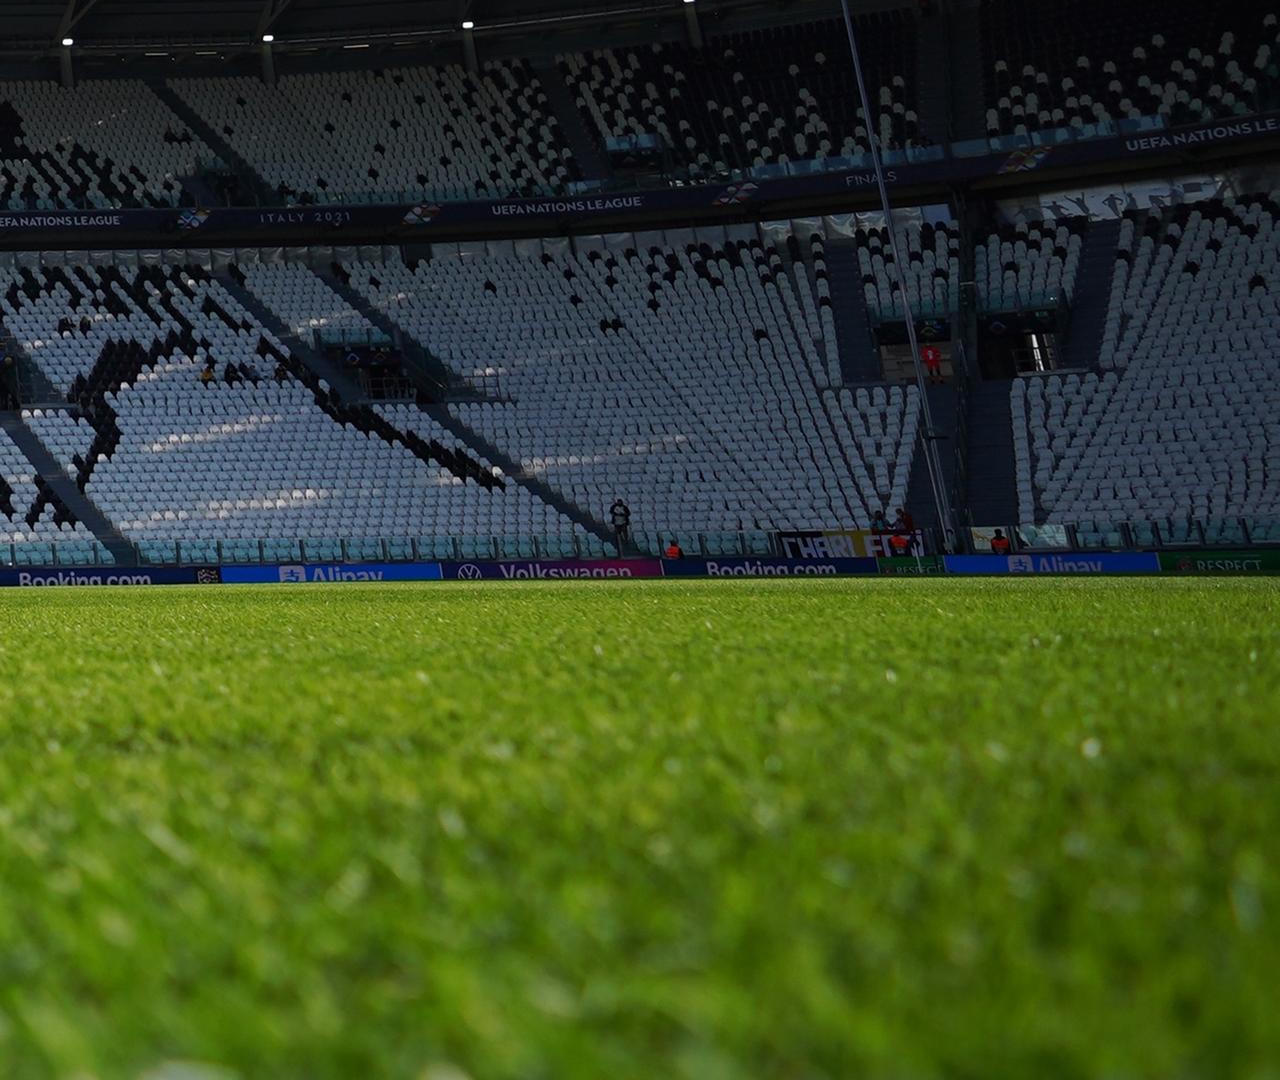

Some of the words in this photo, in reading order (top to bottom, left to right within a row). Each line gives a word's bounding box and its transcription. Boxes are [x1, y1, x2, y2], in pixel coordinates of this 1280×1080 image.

[1126, 135, 1170, 151] UEFA
[1173, 122, 1252, 145] NATIONS
[1255, 118, 1280, 132] LE
[492, 204, 525, 216] UEFA
[526, 201, 585, 213] NATIONS
[587, 197, 641, 209] LEAGUE
[21, 216, 72, 227] NATIONS
[74, 215, 120, 226] LEAGUE
[260, 213, 304, 223] ITALY
[500, 563, 632, 579] Volkswagen
